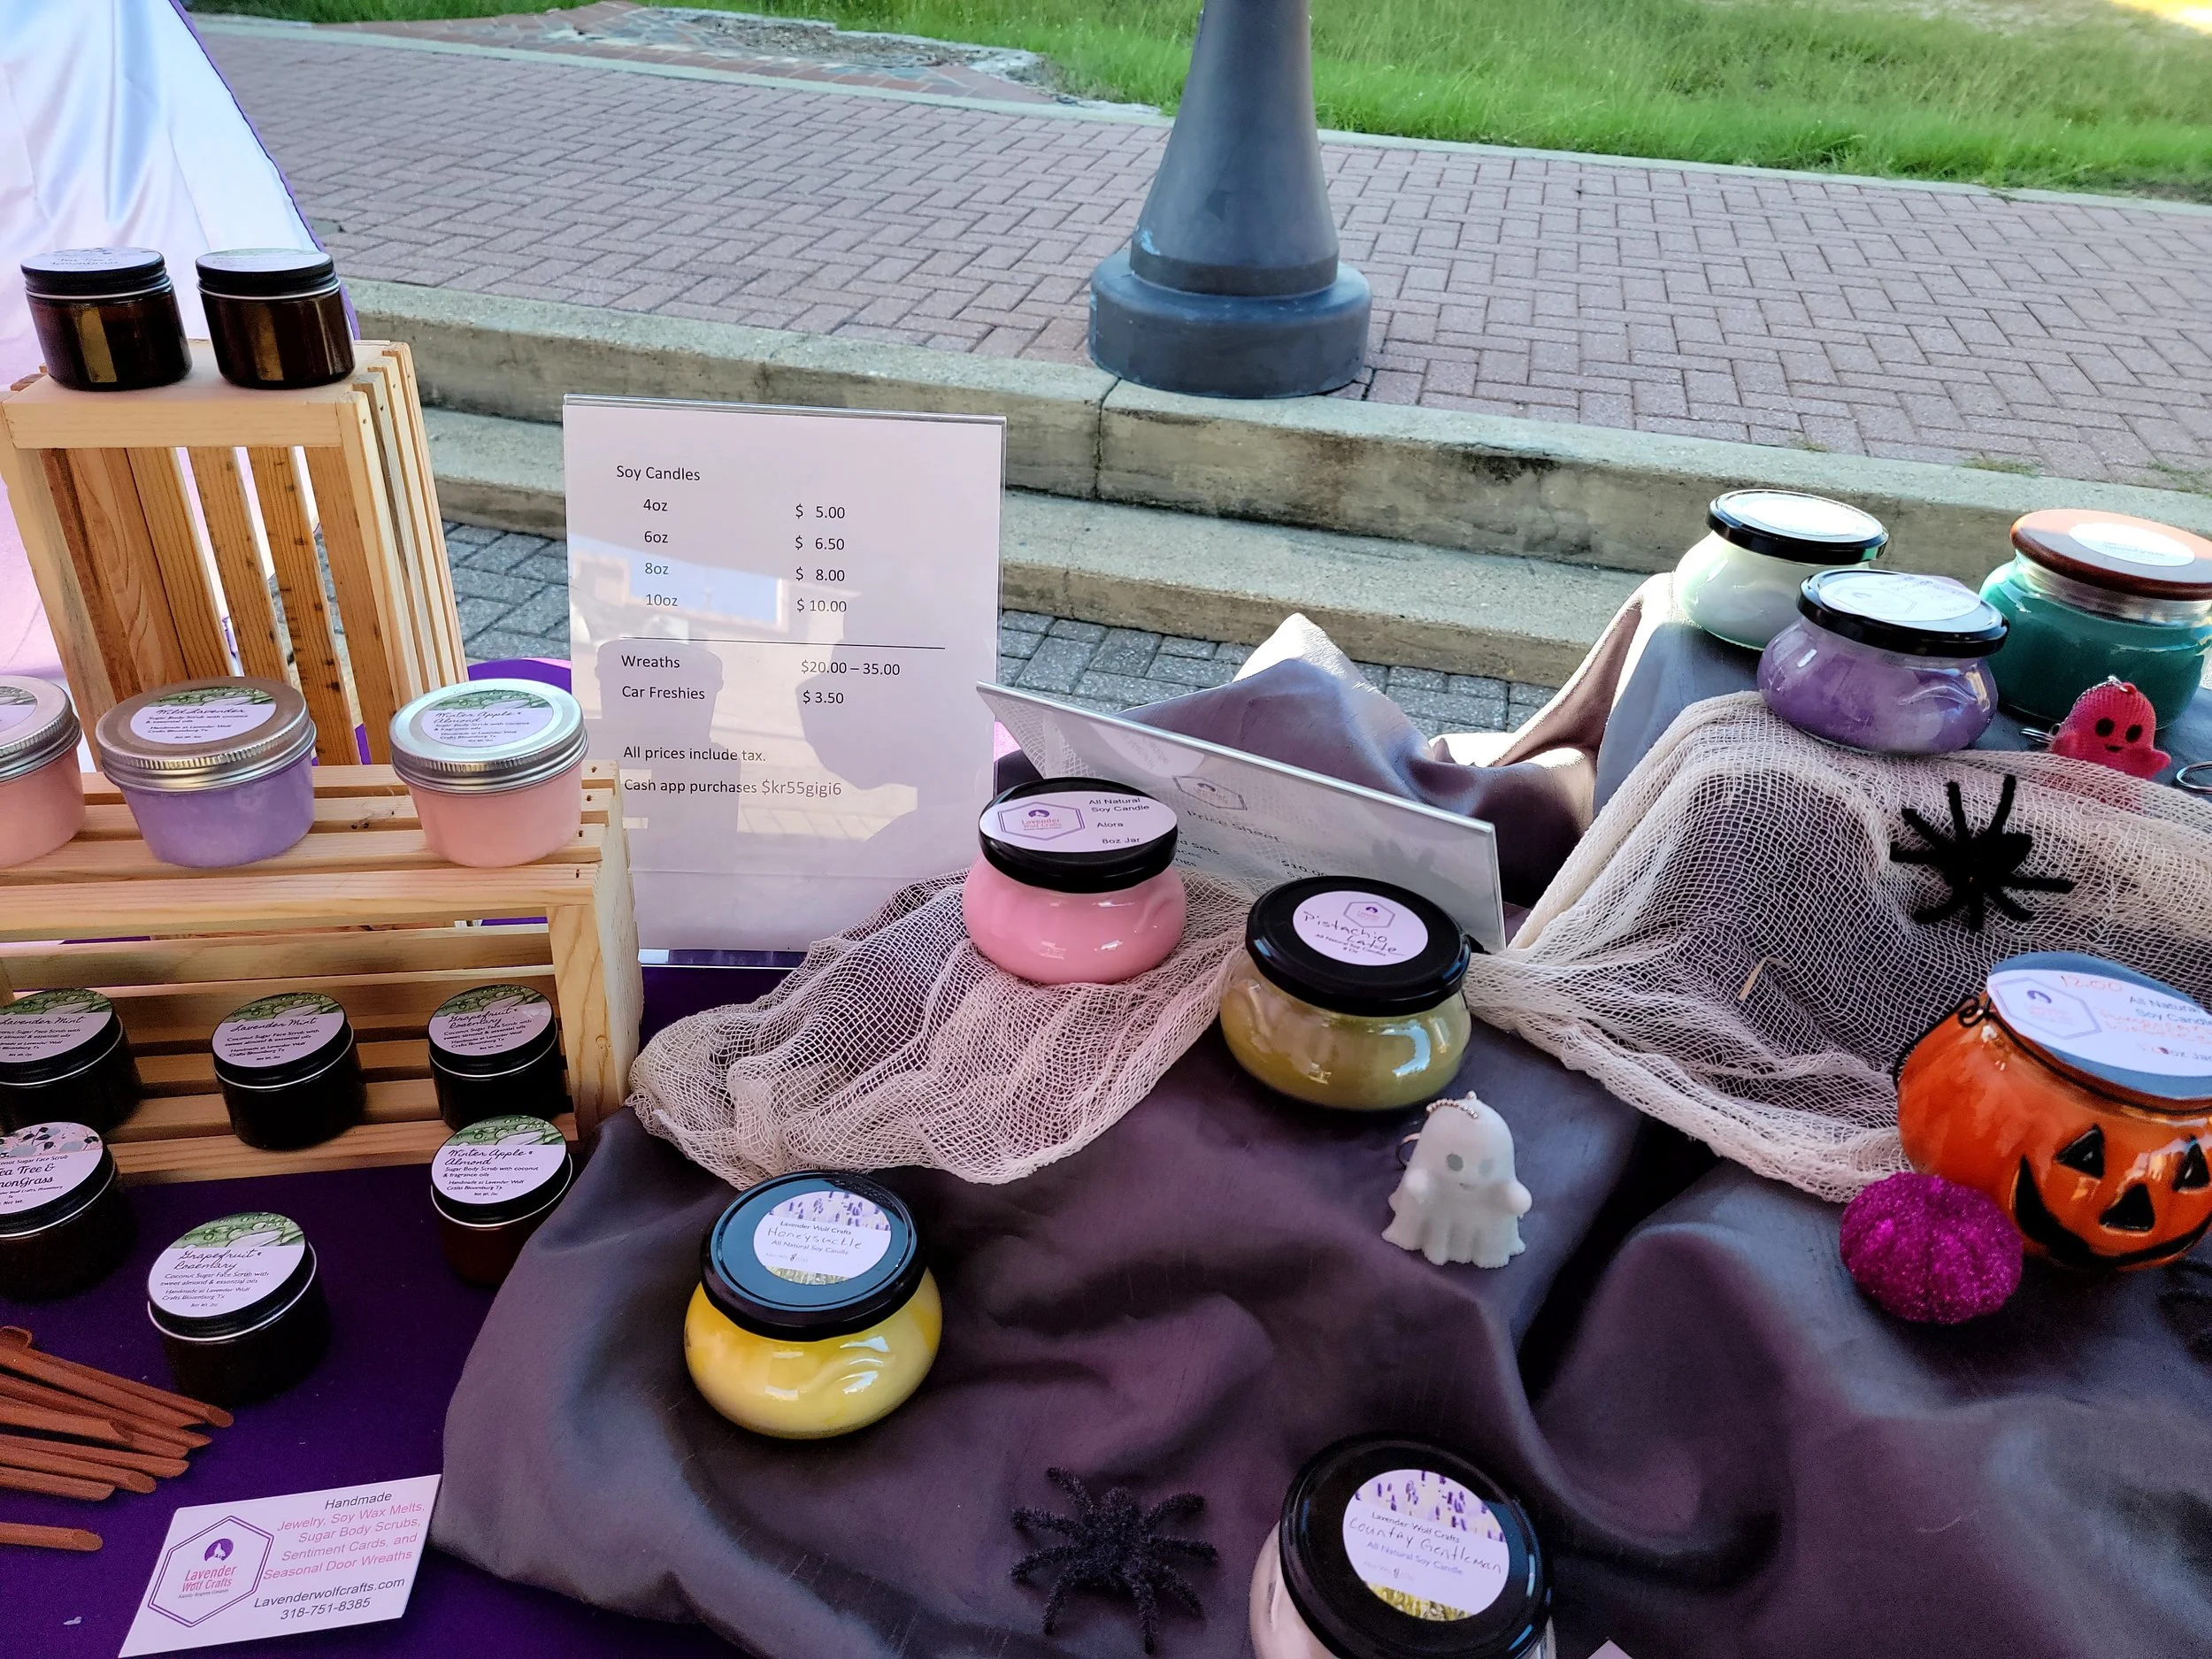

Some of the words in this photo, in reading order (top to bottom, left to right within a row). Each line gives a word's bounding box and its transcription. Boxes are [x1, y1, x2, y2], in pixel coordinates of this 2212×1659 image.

[617, 465, 641, 480] Soy
[646, 467, 700, 480] Candles
[643, 499, 667, 511] 4oz
[796, 503, 803, 518] $
[816, 506, 845, 518] 5.00
[645, 531, 668, 542] 6oz
[795, 535, 803, 550] $
[816, 538, 844, 549] 6.50
[645, 563, 668, 574] 8oz
[796, 567, 803, 580] $
[816, 569, 844, 581] 8.00
[647, 595, 678, 606] 10oz
[797, 598, 804, 612] $
[810, 601, 846, 612] 10.00
[621, 656, 680, 668] Wreaths
[802, 660, 847, 673] $20.00
[864, 664, 900, 675] 35.00
[623, 686, 645, 697] Car
[650, 687, 704, 699] Freshies
[803, 690, 810, 704] $
[815, 692, 843, 703] 3.50
[624, 746, 640, 757] All
[646, 748, 685, 761] prices
[690, 749, 737, 760] include
[742, 750, 765, 761] tax.
[625, 780, 656, 790] Cash
[661, 783, 685, 794] app
[690, 780, 757, 794] purchases
[762, 779, 841, 797] $kr55gigi6
[230, 1021, 287, 1032] Lavender
[288, 1017, 319, 1026] Mint
[488, 1148, 526, 1160] Apple
[17, 1165, 42, 1174] Tree
[177, 1248, 257, 1263] Grapefruit
[325, 1491, 392, 1509] Handmade
[277, 1517, 326, 1532] Jewelry,
[331, 1512, 356, 1525] Soy
[359, 1508, 386, 1520] Wax
[389, 1503, 426, 1516] Melts,
[298, 1529, 337, 1544] Sugar
[340, 1525, 372, 1538] Body
[375, 1517, 421, 1532] Scrubs,
[1349, 1517, 1414, 1549] Country
[1371, 1511, 1408, 1528] Lavender
[1411, 1522, 1432, 1535] Wolf
[1434, 1530, 1460, 1543] Crafts
[282, 1545, 347, 1561] Sentiment
[349, 1540, 389, 1552] Cards,
[393, 1532, 418, 1545] and
[263, 1563, 324, 1579] Seasonal
[326, 1558, 357, 1571] Door
[361, 1550, 413, 1565] Wreaths
[1381, 1546, 1413, 1561] Natural
[1416, 1555, 1430, 1567] Soy
[1433, 1561, 1463, 1574] Candle
[185, 1564, 237, 1579] Lavender
[182, 1579, 204, 1592] Wolf
[204, 1577, 232, 1590] Crafts
[254, 1578, 405, 1608] Lavenderwolfcrafts.com
[280, 1597, 371, 1620] 318-751-8385
